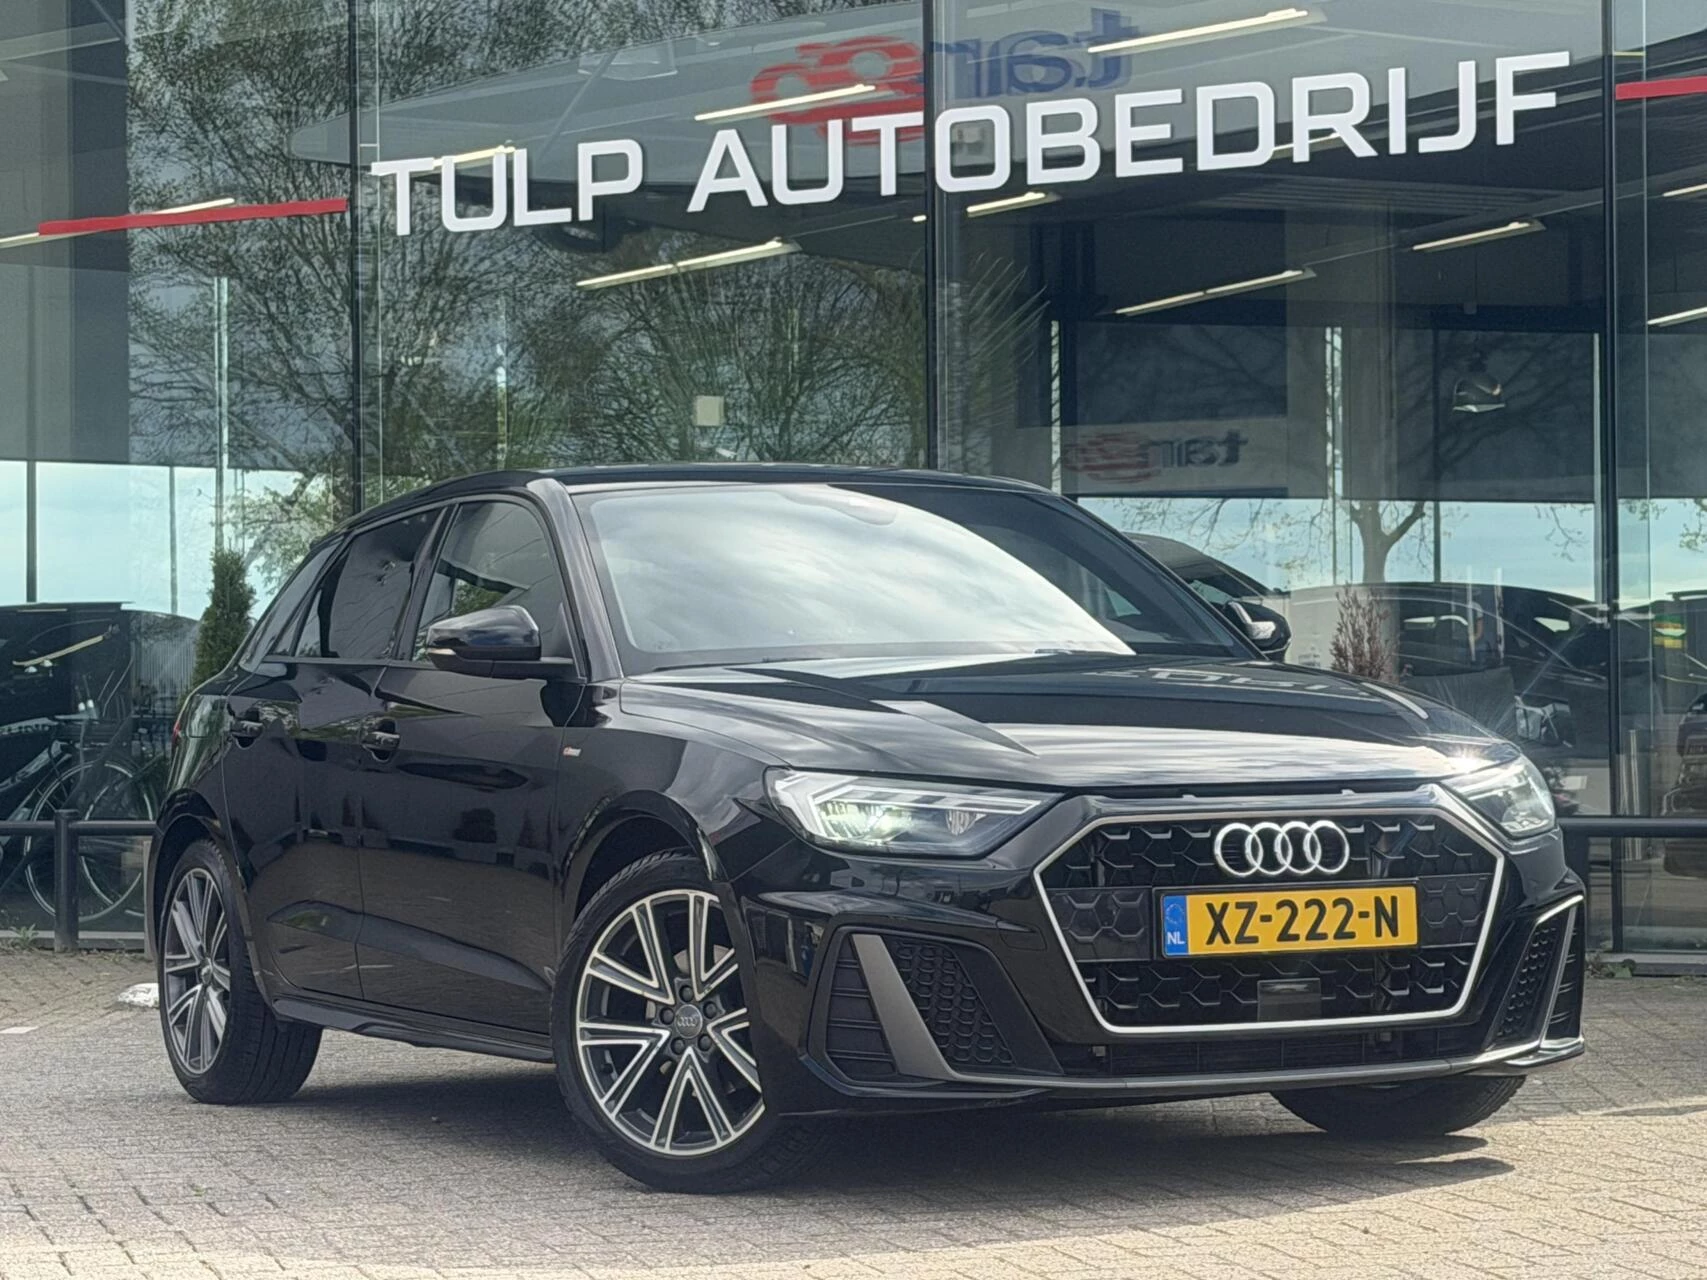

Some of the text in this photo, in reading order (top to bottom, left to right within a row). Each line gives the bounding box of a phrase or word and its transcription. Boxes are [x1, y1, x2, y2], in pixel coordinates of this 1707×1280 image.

[371, 51, 1571, 236] TULP AUTOBEDRIJF
[1166, 931, 1186, 945] NL
[1205, 895, 1400, 946] XZ-222-N
